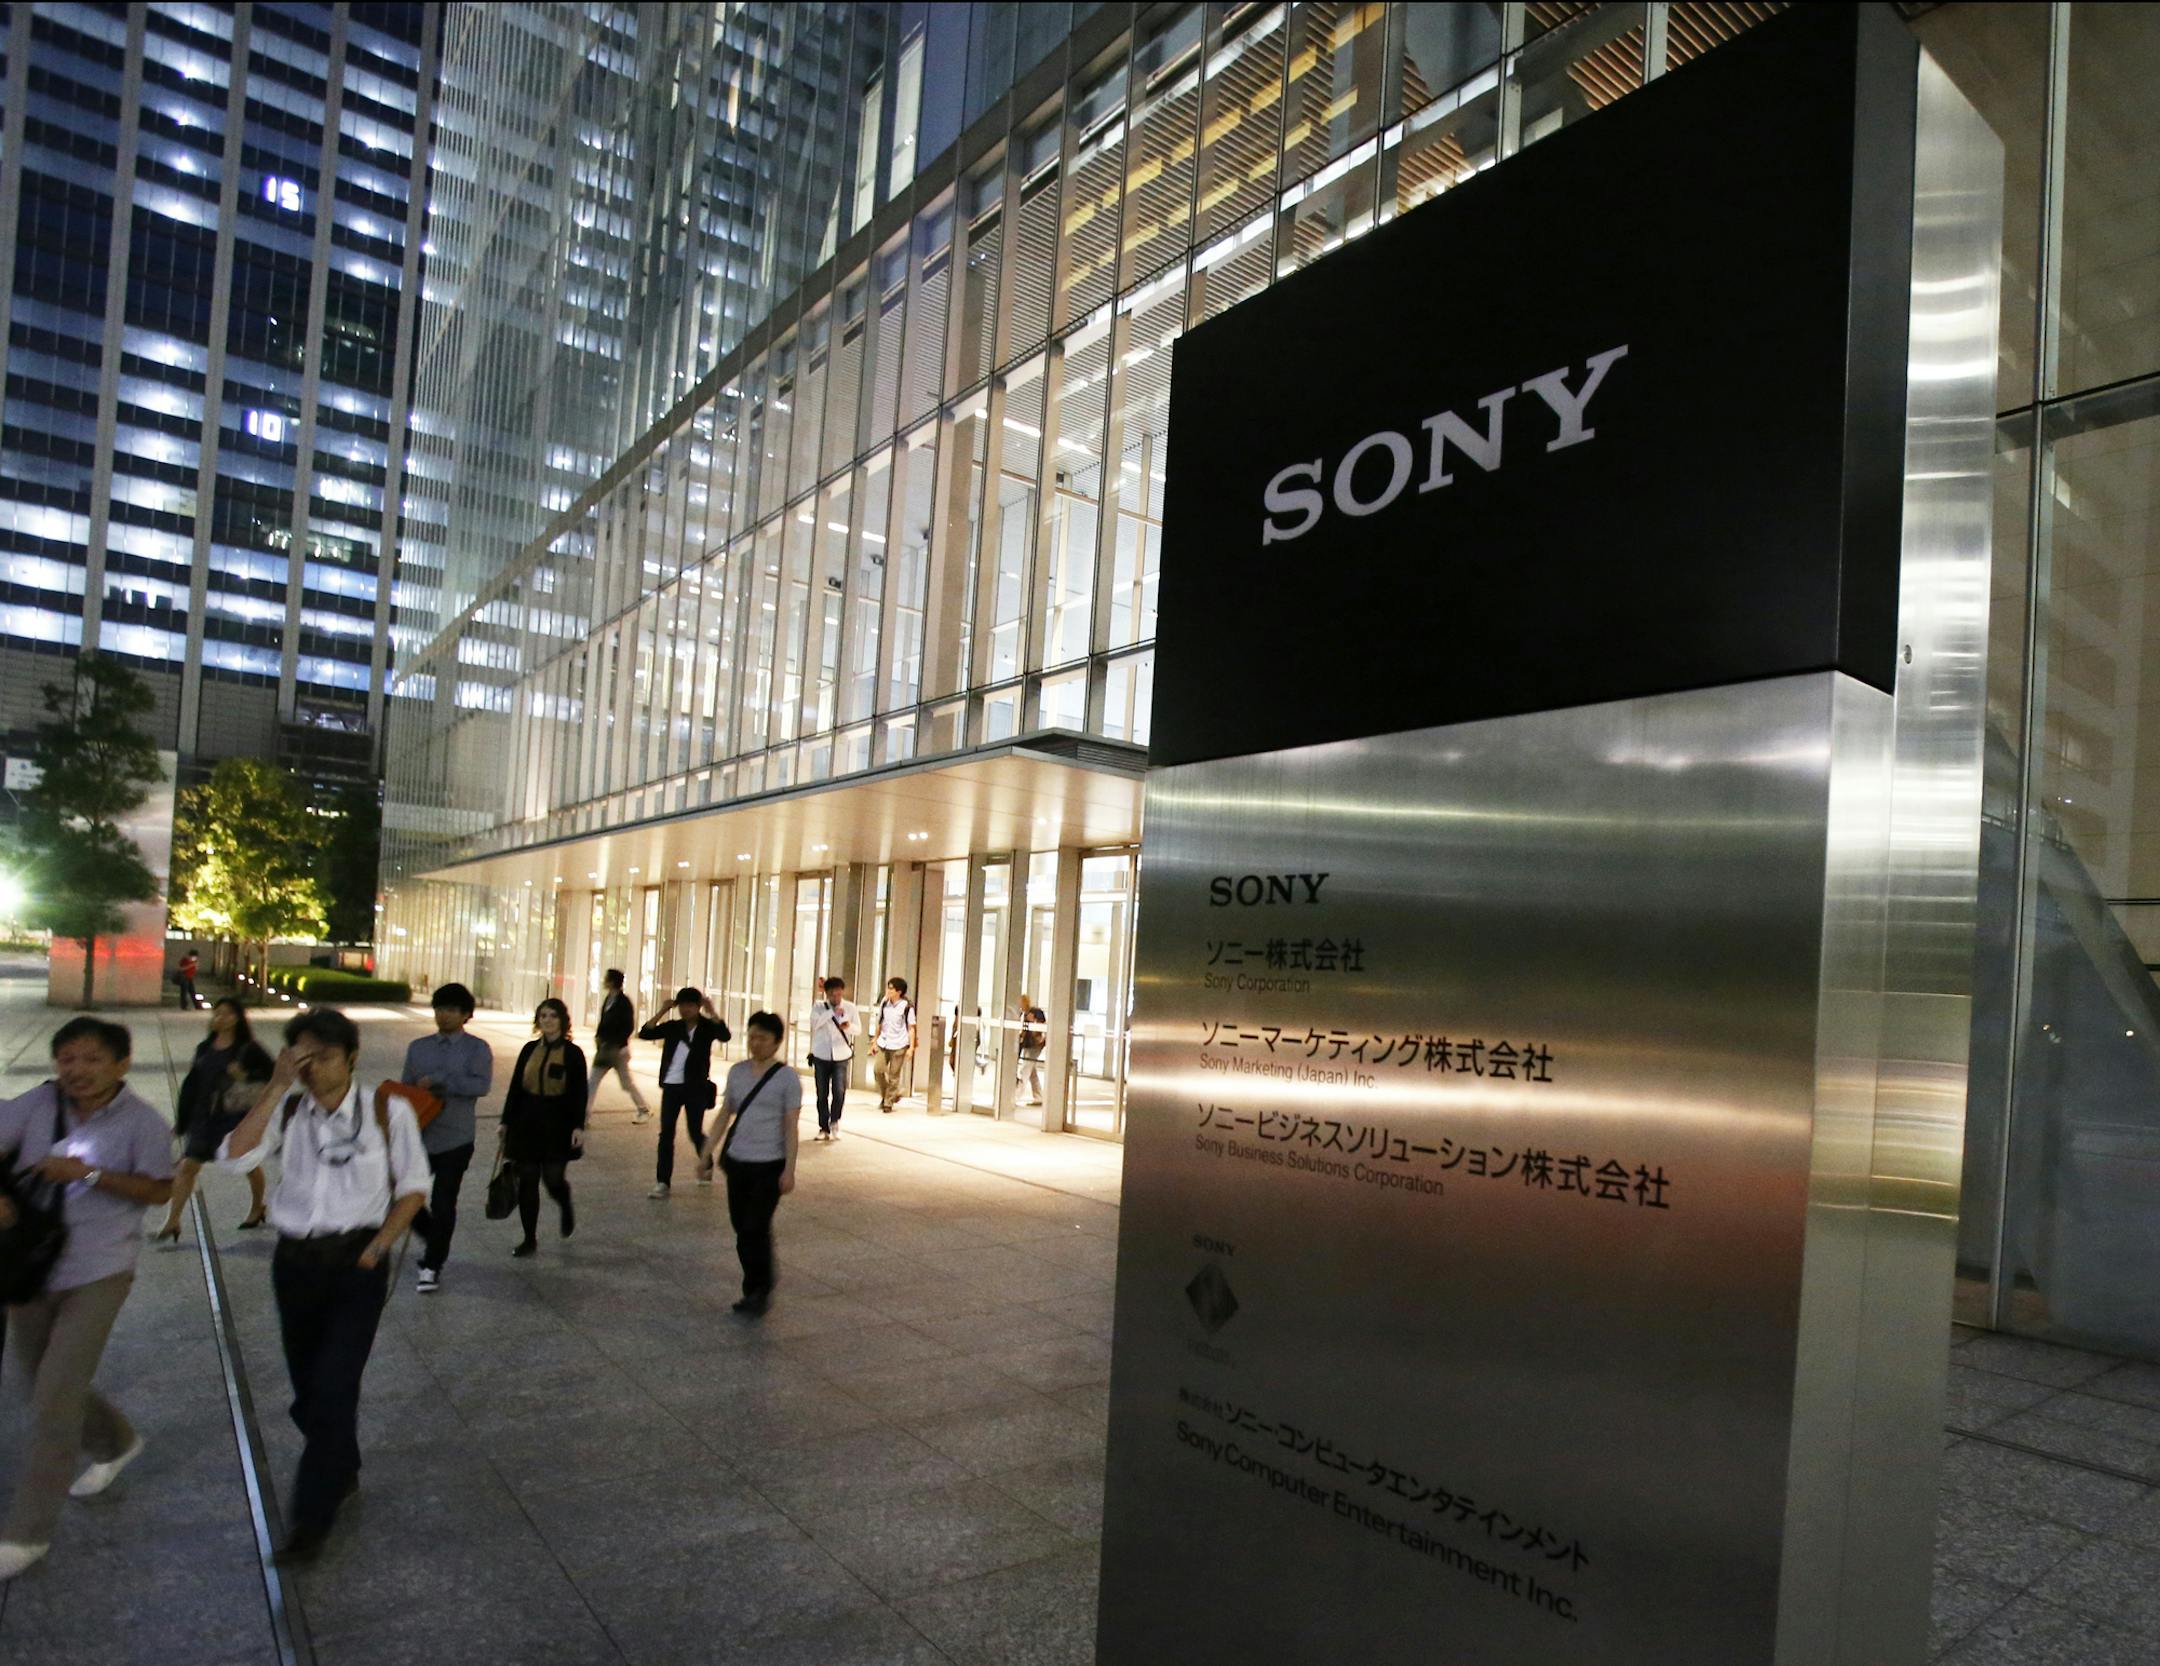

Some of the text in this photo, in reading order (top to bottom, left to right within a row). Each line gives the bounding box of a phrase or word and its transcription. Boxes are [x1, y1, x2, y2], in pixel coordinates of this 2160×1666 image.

[1262, 344, 1629, 547] SONY
[1209, 873, 1330, 907] SONY
[1207, 938, 1366, 973] ソニー株式会社
[1204, 972, 1311, 995] Sony Corporation
[1200, 1052, 1379, 1089] Sony Marketing (Japan) Inc.
[1202, 1022, 1554, 1083] ソニーマーケティング株式会社
[1195, 1133, 1445, 1196] Sony Business Solutions Corporation
[1197, 1103, 1671, 1210] ソニービジネスソリューション株式会社
[1191, 1233, 1236, 1257] SONY
[1176, 1420, 1579, 1623] Sony Computer Entertainment Inc.
